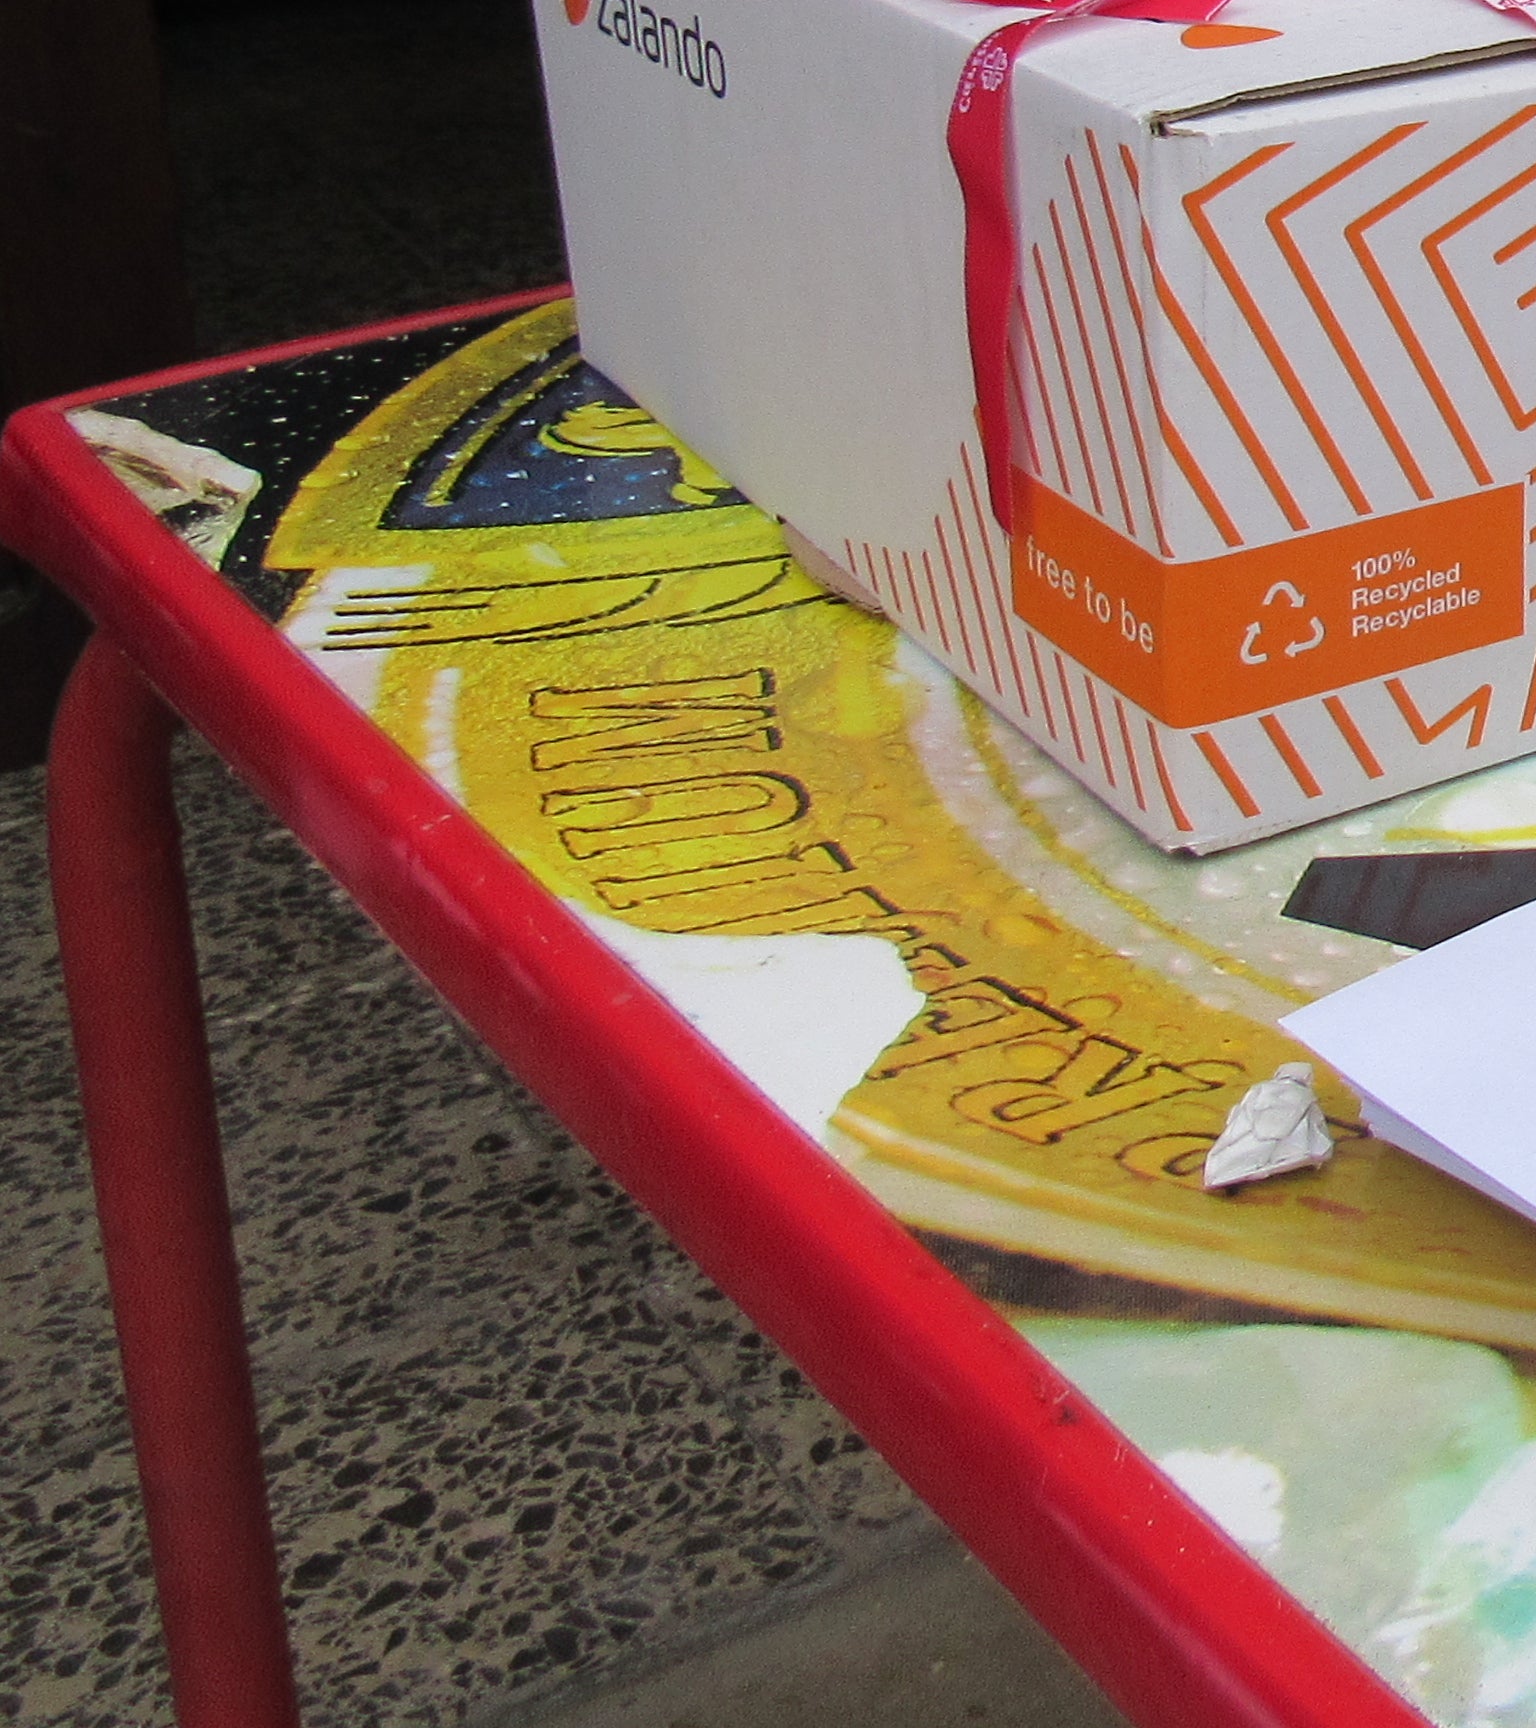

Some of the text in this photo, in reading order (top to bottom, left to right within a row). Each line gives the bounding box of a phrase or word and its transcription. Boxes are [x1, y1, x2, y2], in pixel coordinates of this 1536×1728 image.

[1351, 547, 1416, 582] 100%
[1351, 562, 1460, 611] Recycled
[1026, 534, 1154, 654] free to be
[1352, 587, 1481, 638] Recyclable
